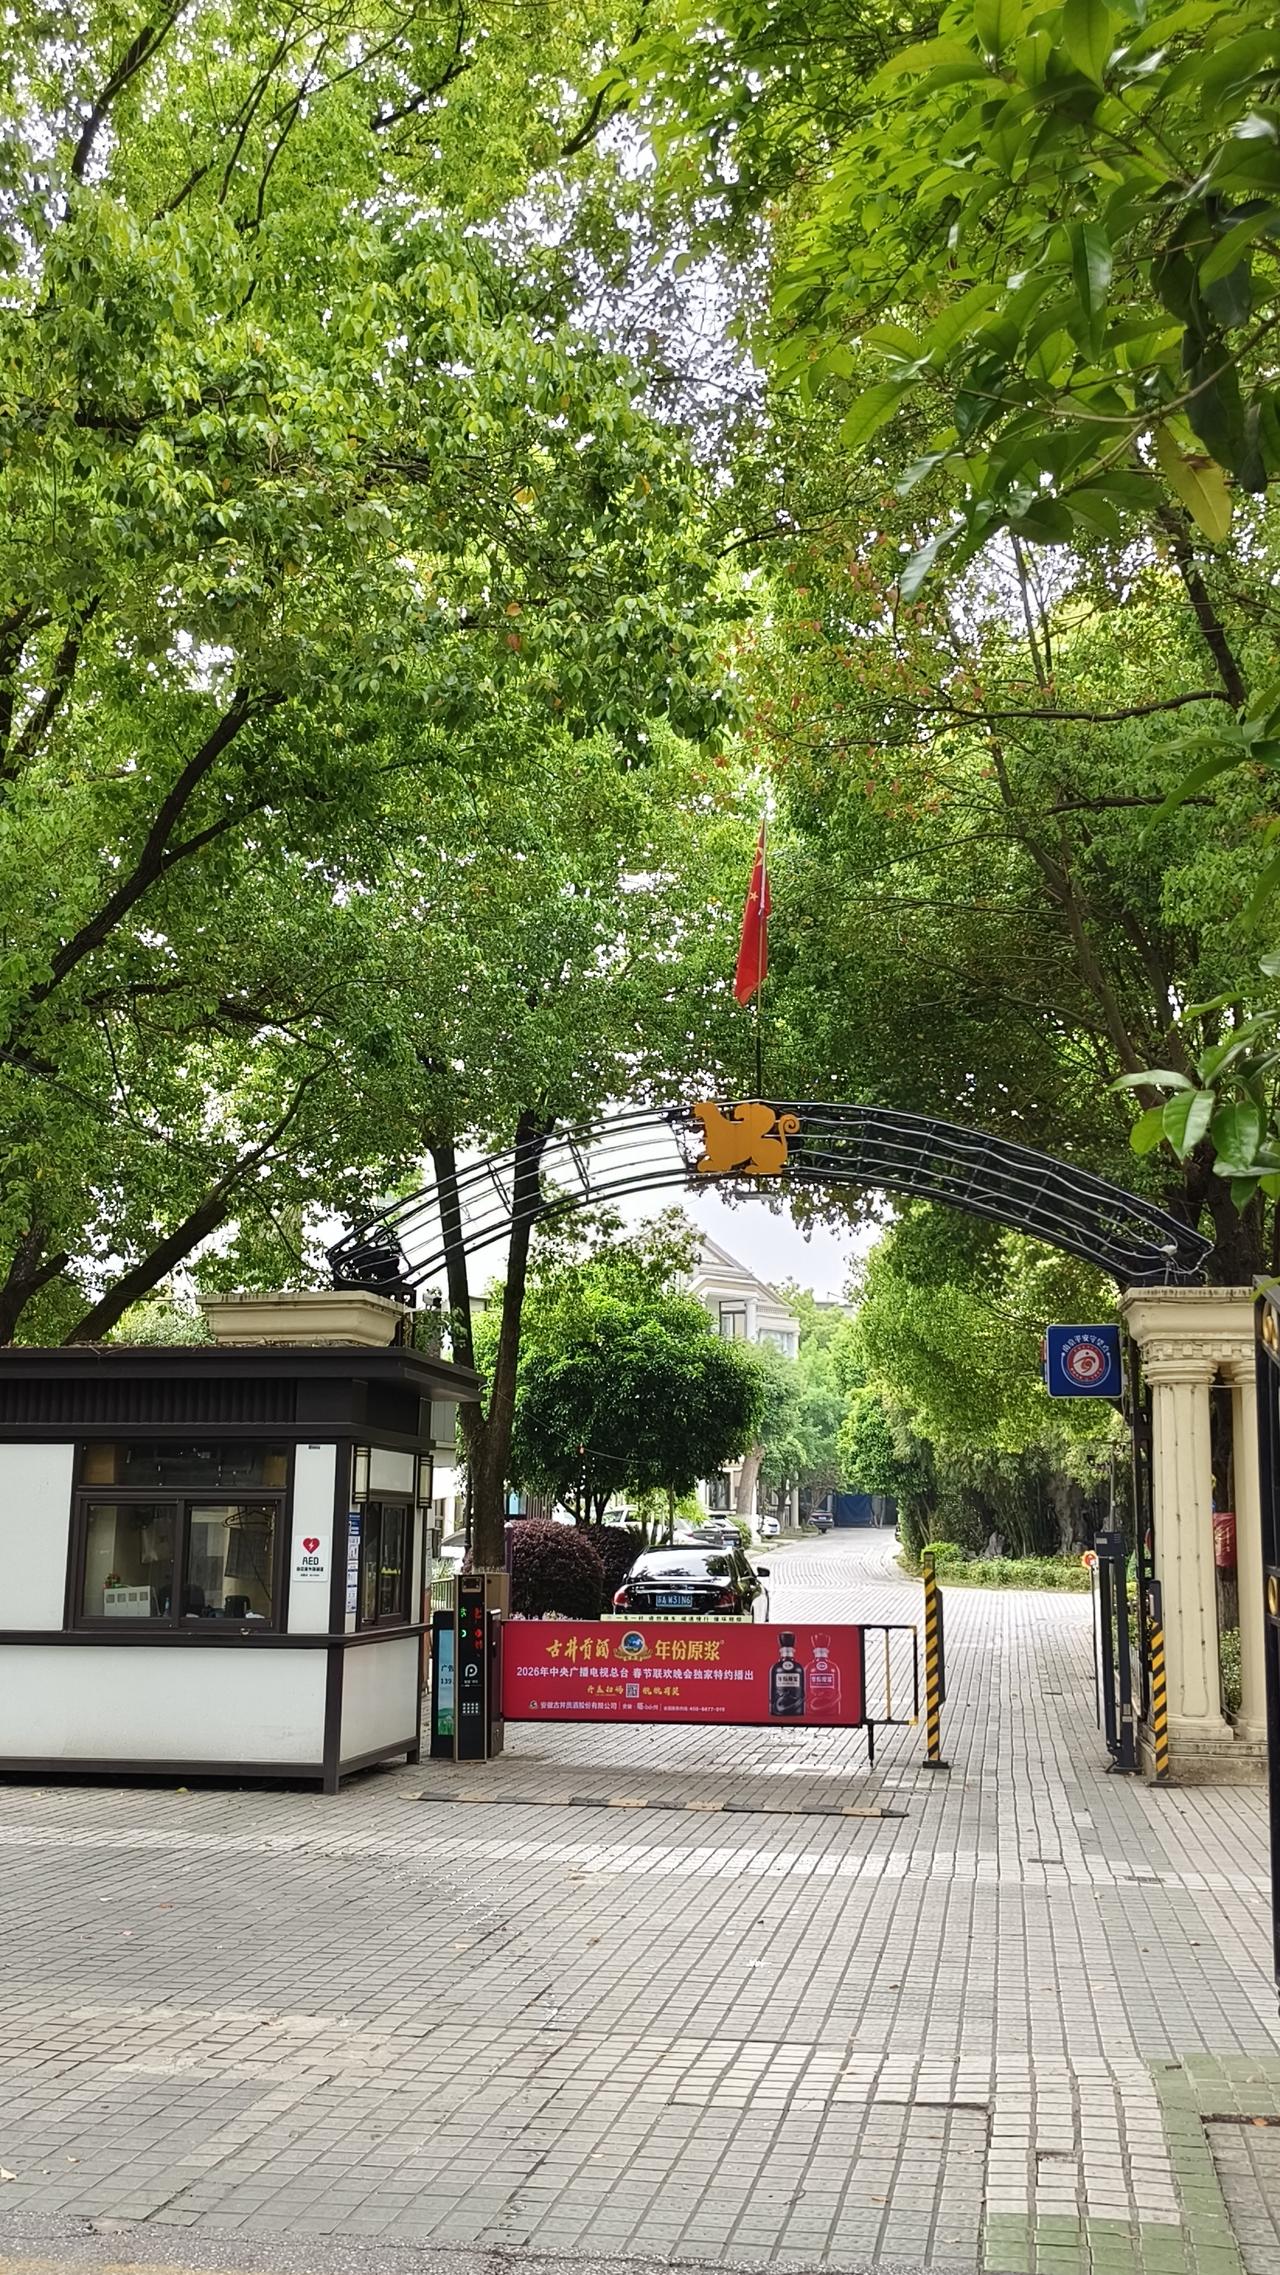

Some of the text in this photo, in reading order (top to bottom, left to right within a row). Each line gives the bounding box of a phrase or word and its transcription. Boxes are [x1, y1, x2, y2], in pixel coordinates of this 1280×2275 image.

[302, 1557, 319, 1566] AED
[546, 1636, 720, 1663] 古井贡酒 年份原浆
[516, 1666, 754, 1681] 2026年中央广播电视总台 春节联欢晚会独家特约播出
